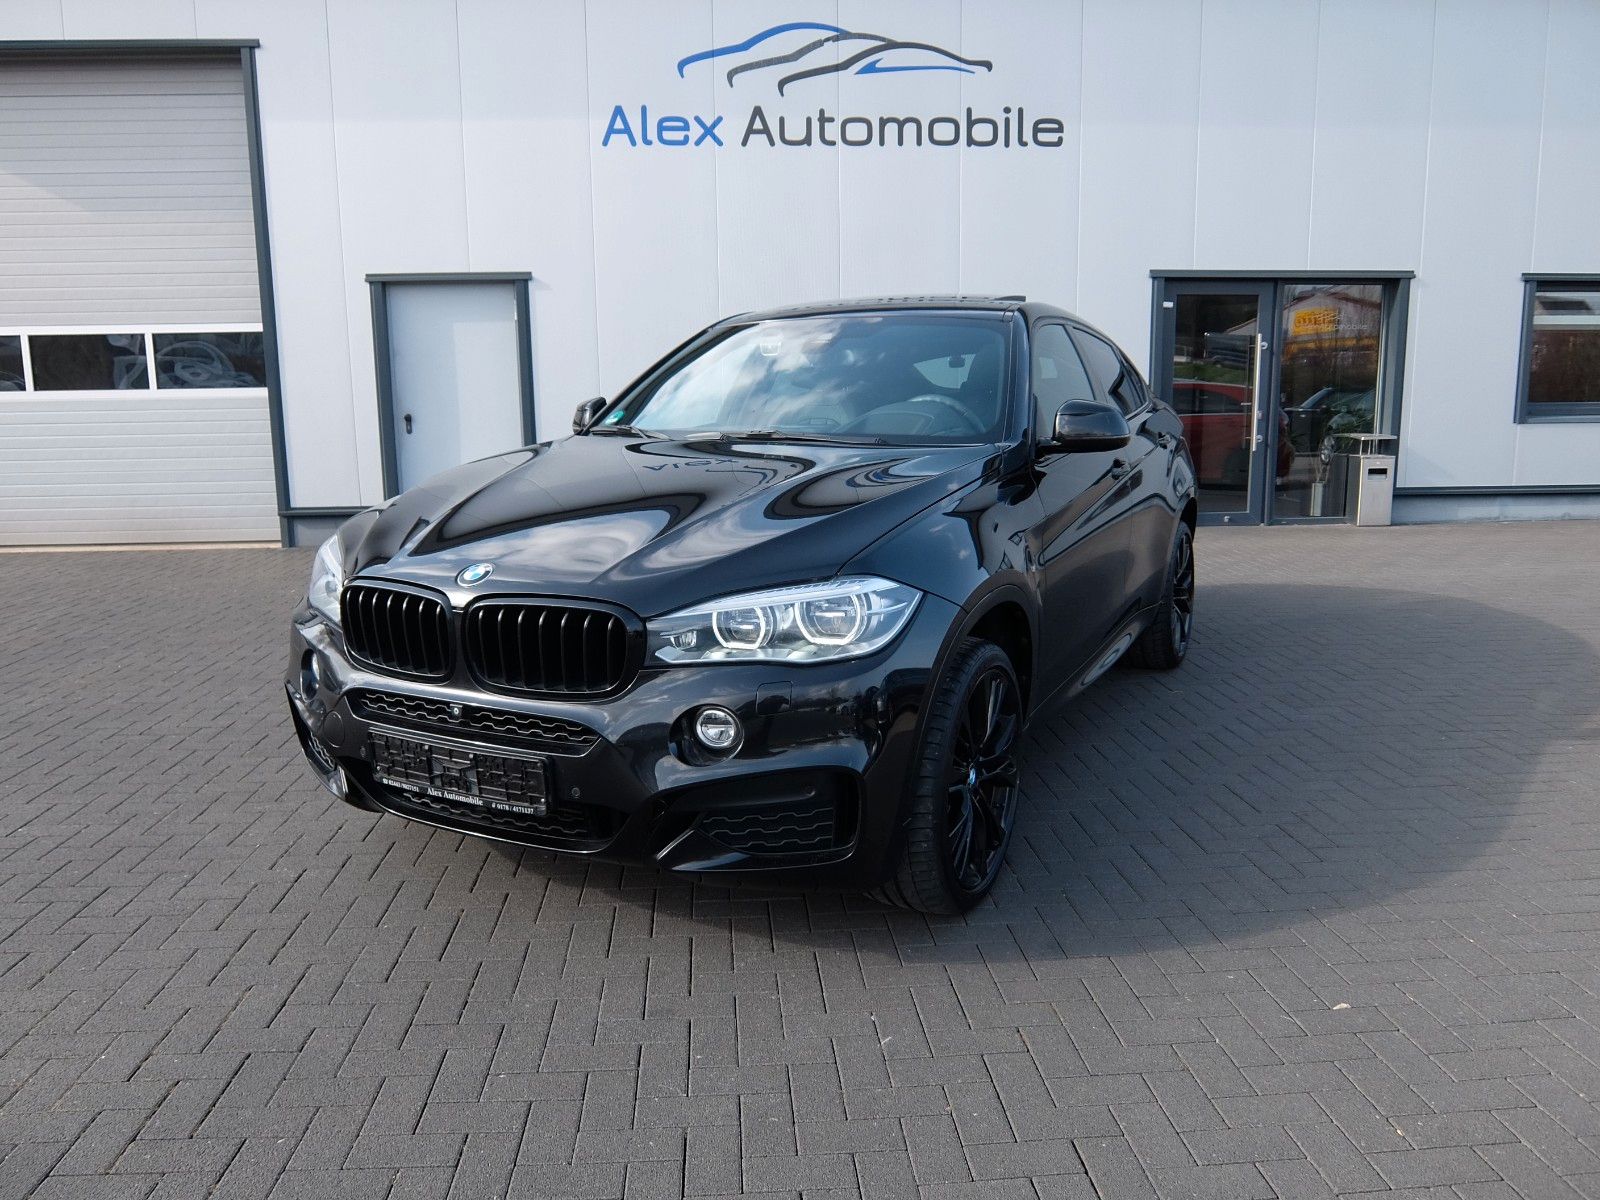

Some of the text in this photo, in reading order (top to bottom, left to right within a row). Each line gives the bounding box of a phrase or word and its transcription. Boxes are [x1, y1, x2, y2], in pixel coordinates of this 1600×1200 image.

[602, 104, 1064, 147] Alex Automobile
[426, 787, 483, 806] Alex Automobile
